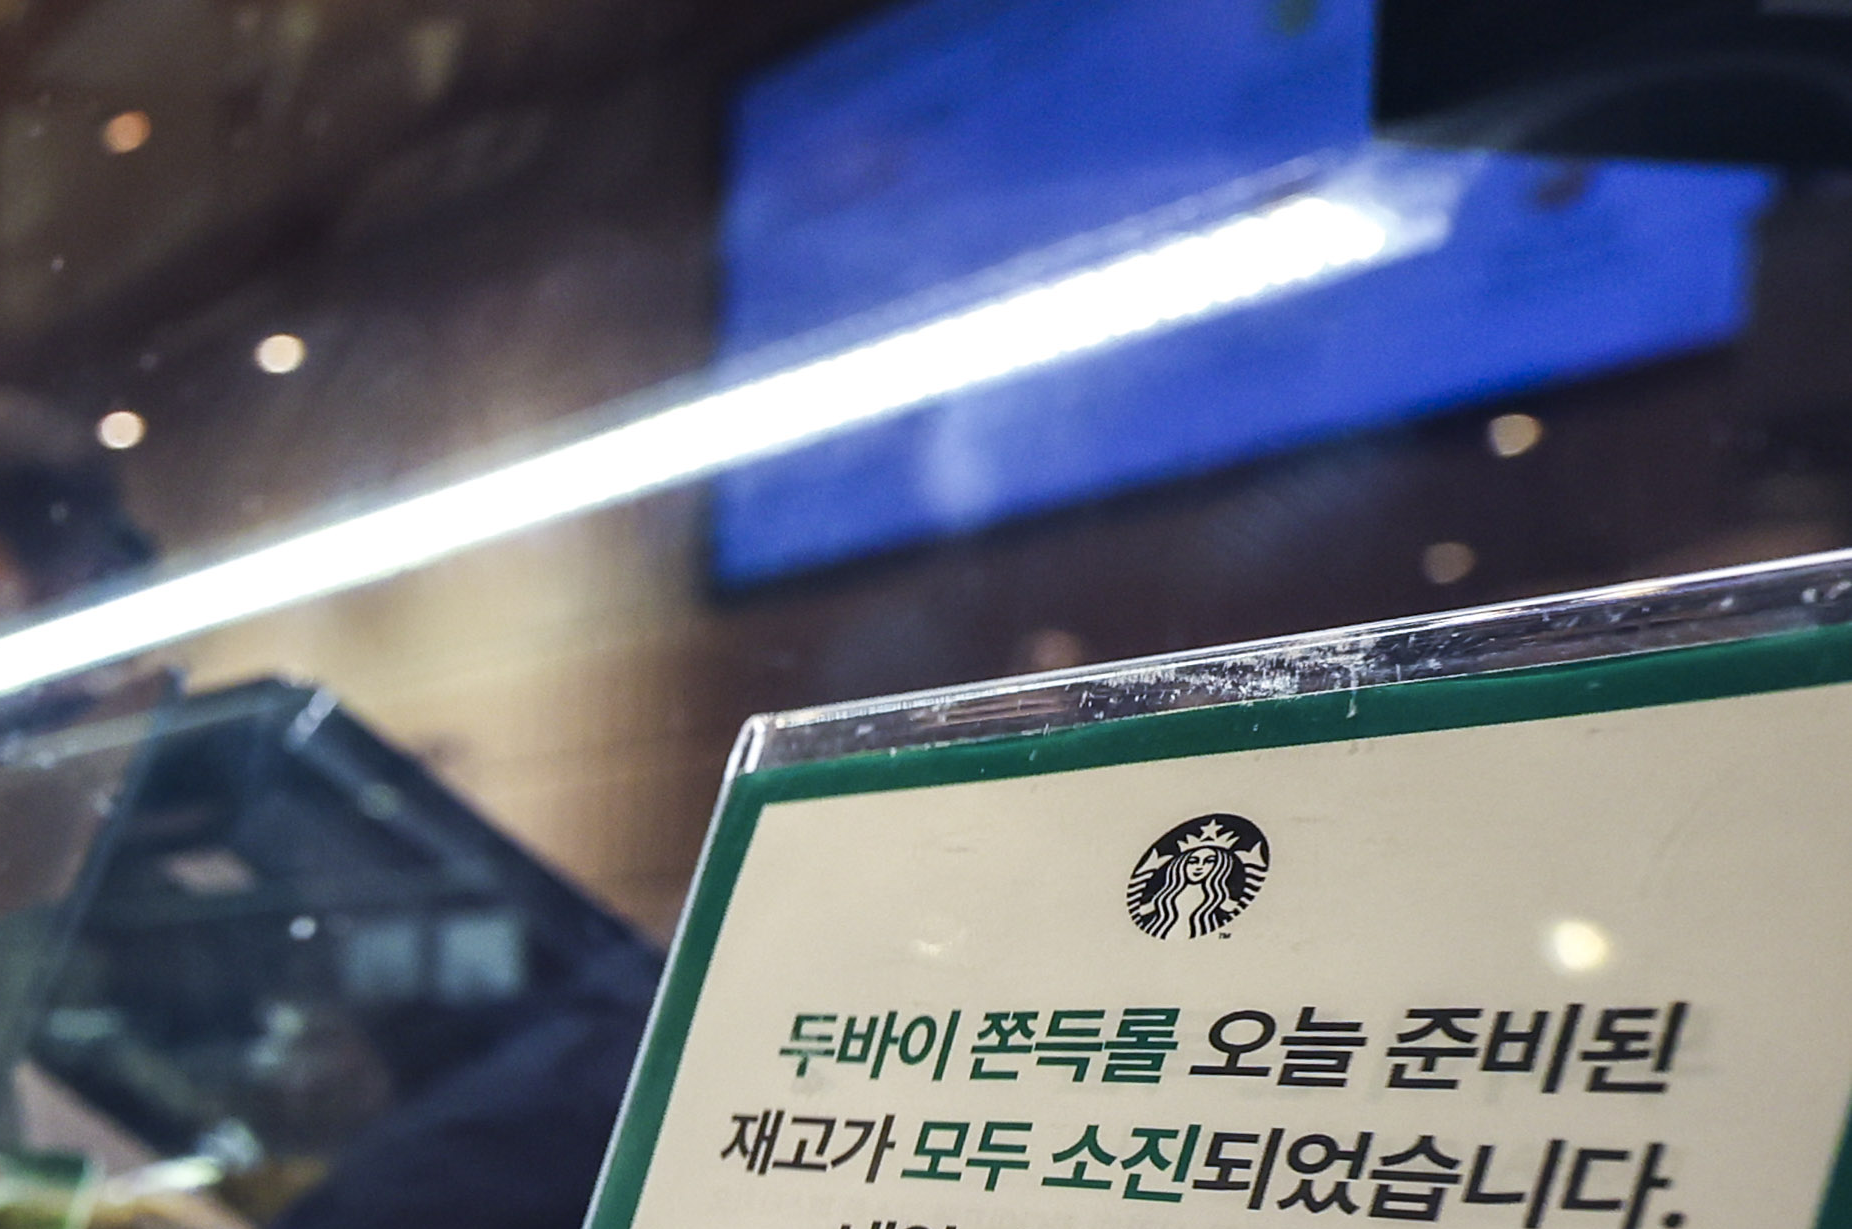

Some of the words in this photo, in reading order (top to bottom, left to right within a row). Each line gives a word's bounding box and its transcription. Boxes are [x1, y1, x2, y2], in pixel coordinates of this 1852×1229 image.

[780, 1011, 958, 1080] 두바이
[970, 1008, 1180, 1083] 쫀득롤
[1189, 1007, 1367, 1087] 오늘
[1386, 1002, 1688, 1094] 준비된
[721, 1111, 895, 1182] 재고가
[901, 1122, 1032, 1191] 모두
